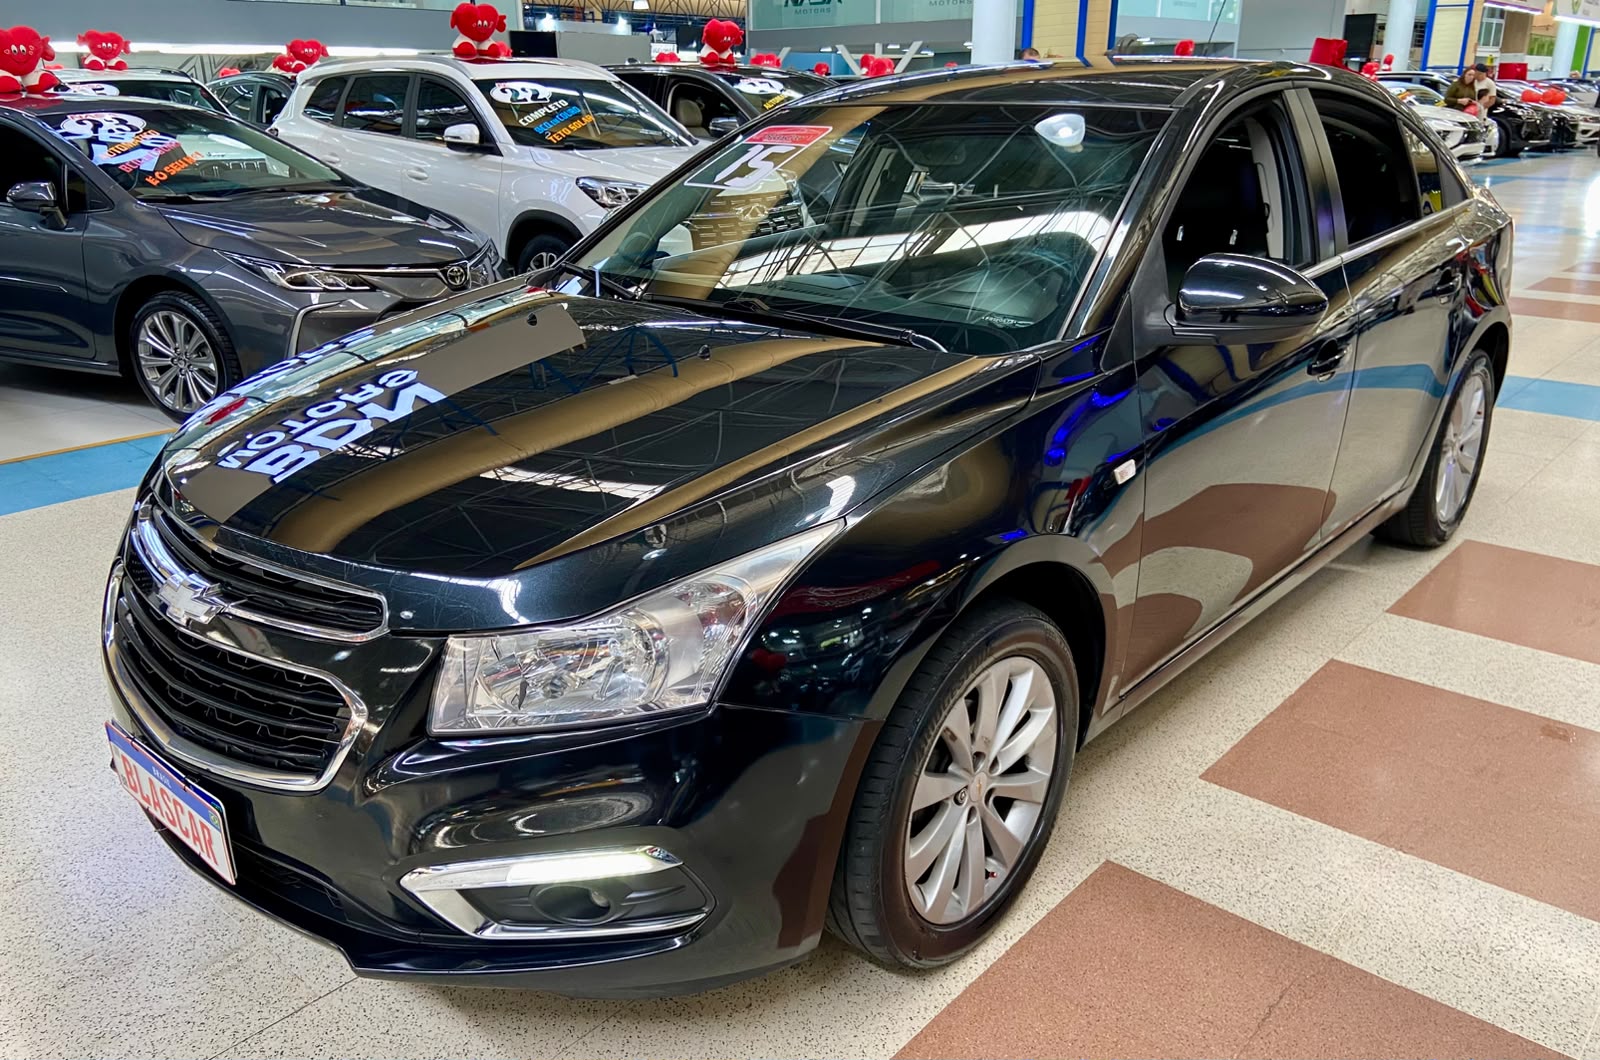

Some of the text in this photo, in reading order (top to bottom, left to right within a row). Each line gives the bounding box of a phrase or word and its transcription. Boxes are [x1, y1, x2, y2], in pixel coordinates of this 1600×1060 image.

[518, 99, 569, 126] COMPLETO
[548, 114, 593, 143] TETO SOLAR
[714, 144, 796, 187] 15
[120, 754, 219, 866] BLASCAR
